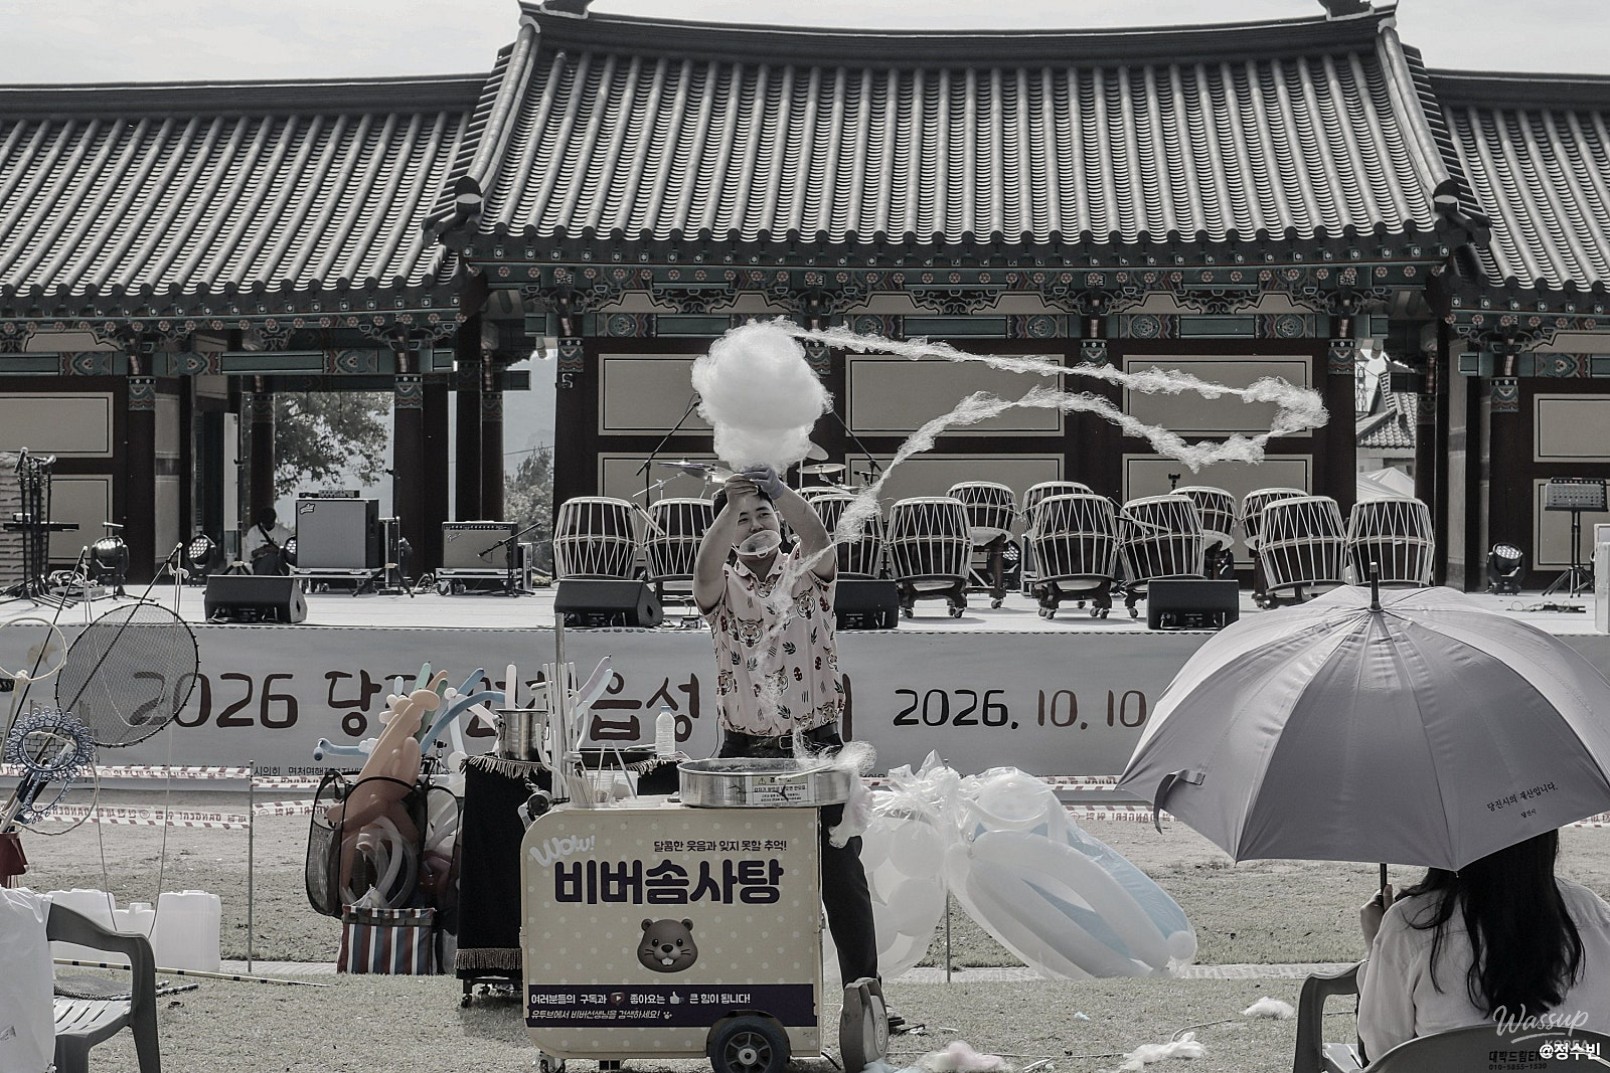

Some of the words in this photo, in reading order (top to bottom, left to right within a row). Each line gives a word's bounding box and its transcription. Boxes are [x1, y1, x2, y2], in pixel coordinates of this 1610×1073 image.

[129, 670, 299, 729] 2026
[466, 671, 700, 743] 읍성
[893, 689, 1019, 730] 2026.
[1038, 689, 1089, 730] 10.
[1106, 689, 1147, 728] 10
[1487, 794, 1518, 812] 당진시의
[654, 840, 684, 852] 달콤한
[686, 840, 717, 852] 웃음과
[719, 840, 740, 852] 잊지
[741, 840, 761, 852] 못할
[764, 840, 787, 852] 추억!
[554, 858, 785, 905] 비버솜사탕
[531, 994, 576, 1004] 여러분들의
[580, 994, 608, 1004] 구독과
[630, 993, 666, 1004] 좋아요는
[689, 993, 699, 1004] 큰
[700, 993, 719, 1004] 힘이
[720, 993, 751, 1004] 됩니다!
[571, 1010, 617, 1019] 비버선생님을
[618, 1010, 661, 1019] 검색하세요!
